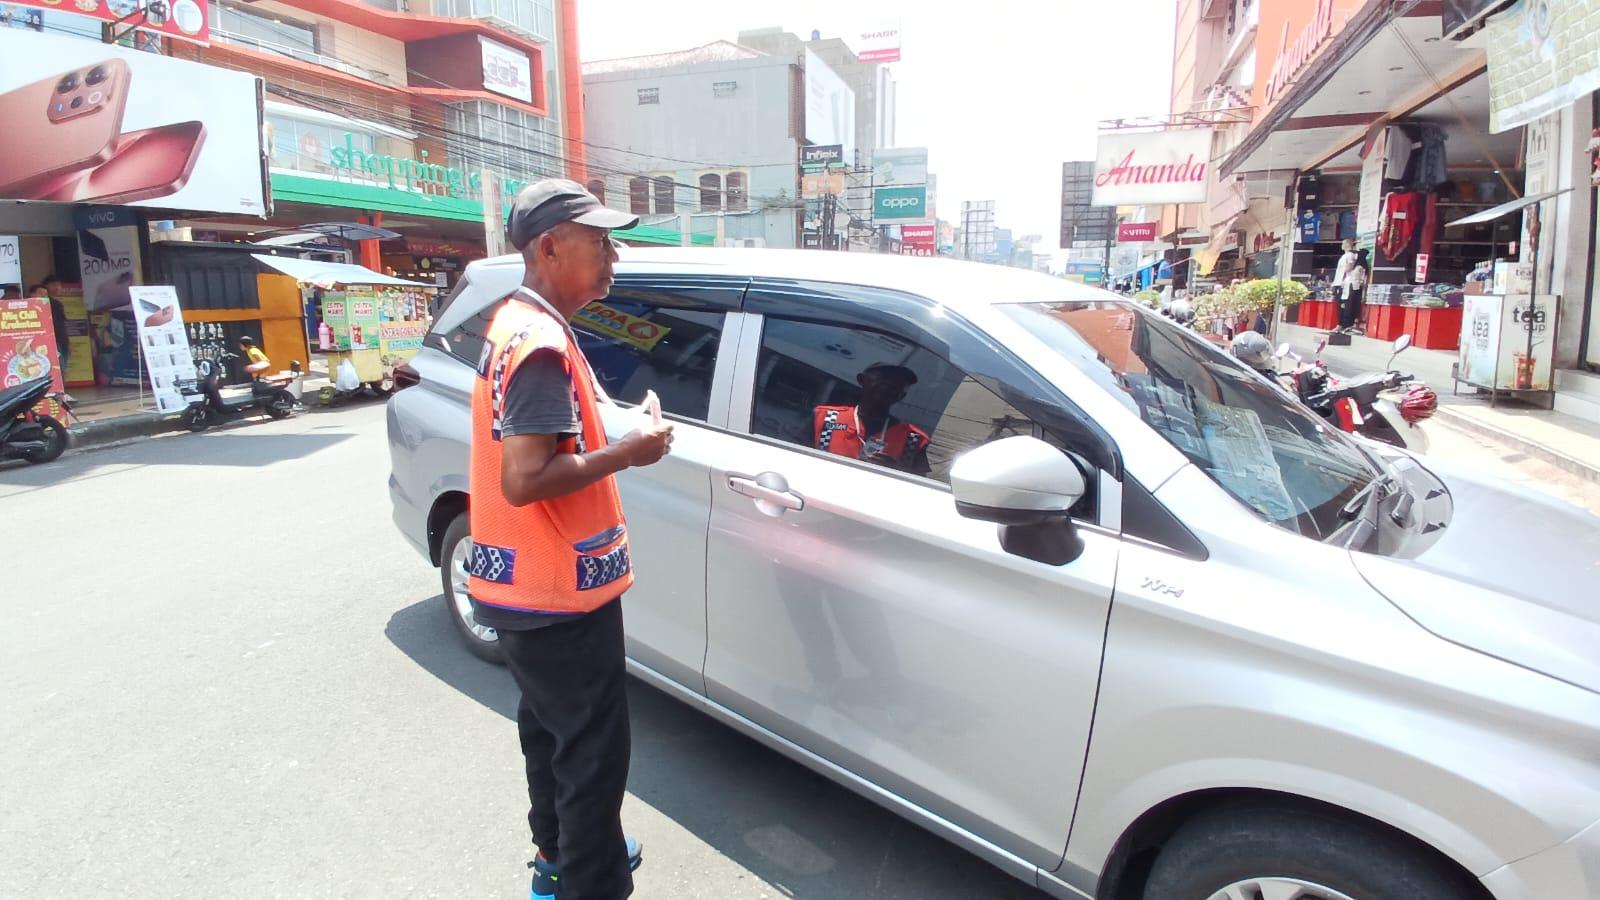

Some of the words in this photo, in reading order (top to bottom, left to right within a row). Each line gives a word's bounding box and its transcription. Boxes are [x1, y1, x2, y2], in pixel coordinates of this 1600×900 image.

[806, 149, 839, 160] Infinix
[331, 132, 465, 200] shopping
[1095, 148, 1206, 187] Ananda
[882, 196, 919, 208] oppo
[83, 257, 131, 275] 200MP
[1512, 307, 1546, 323] tea
[1472, 320, 1489, 337] tea
